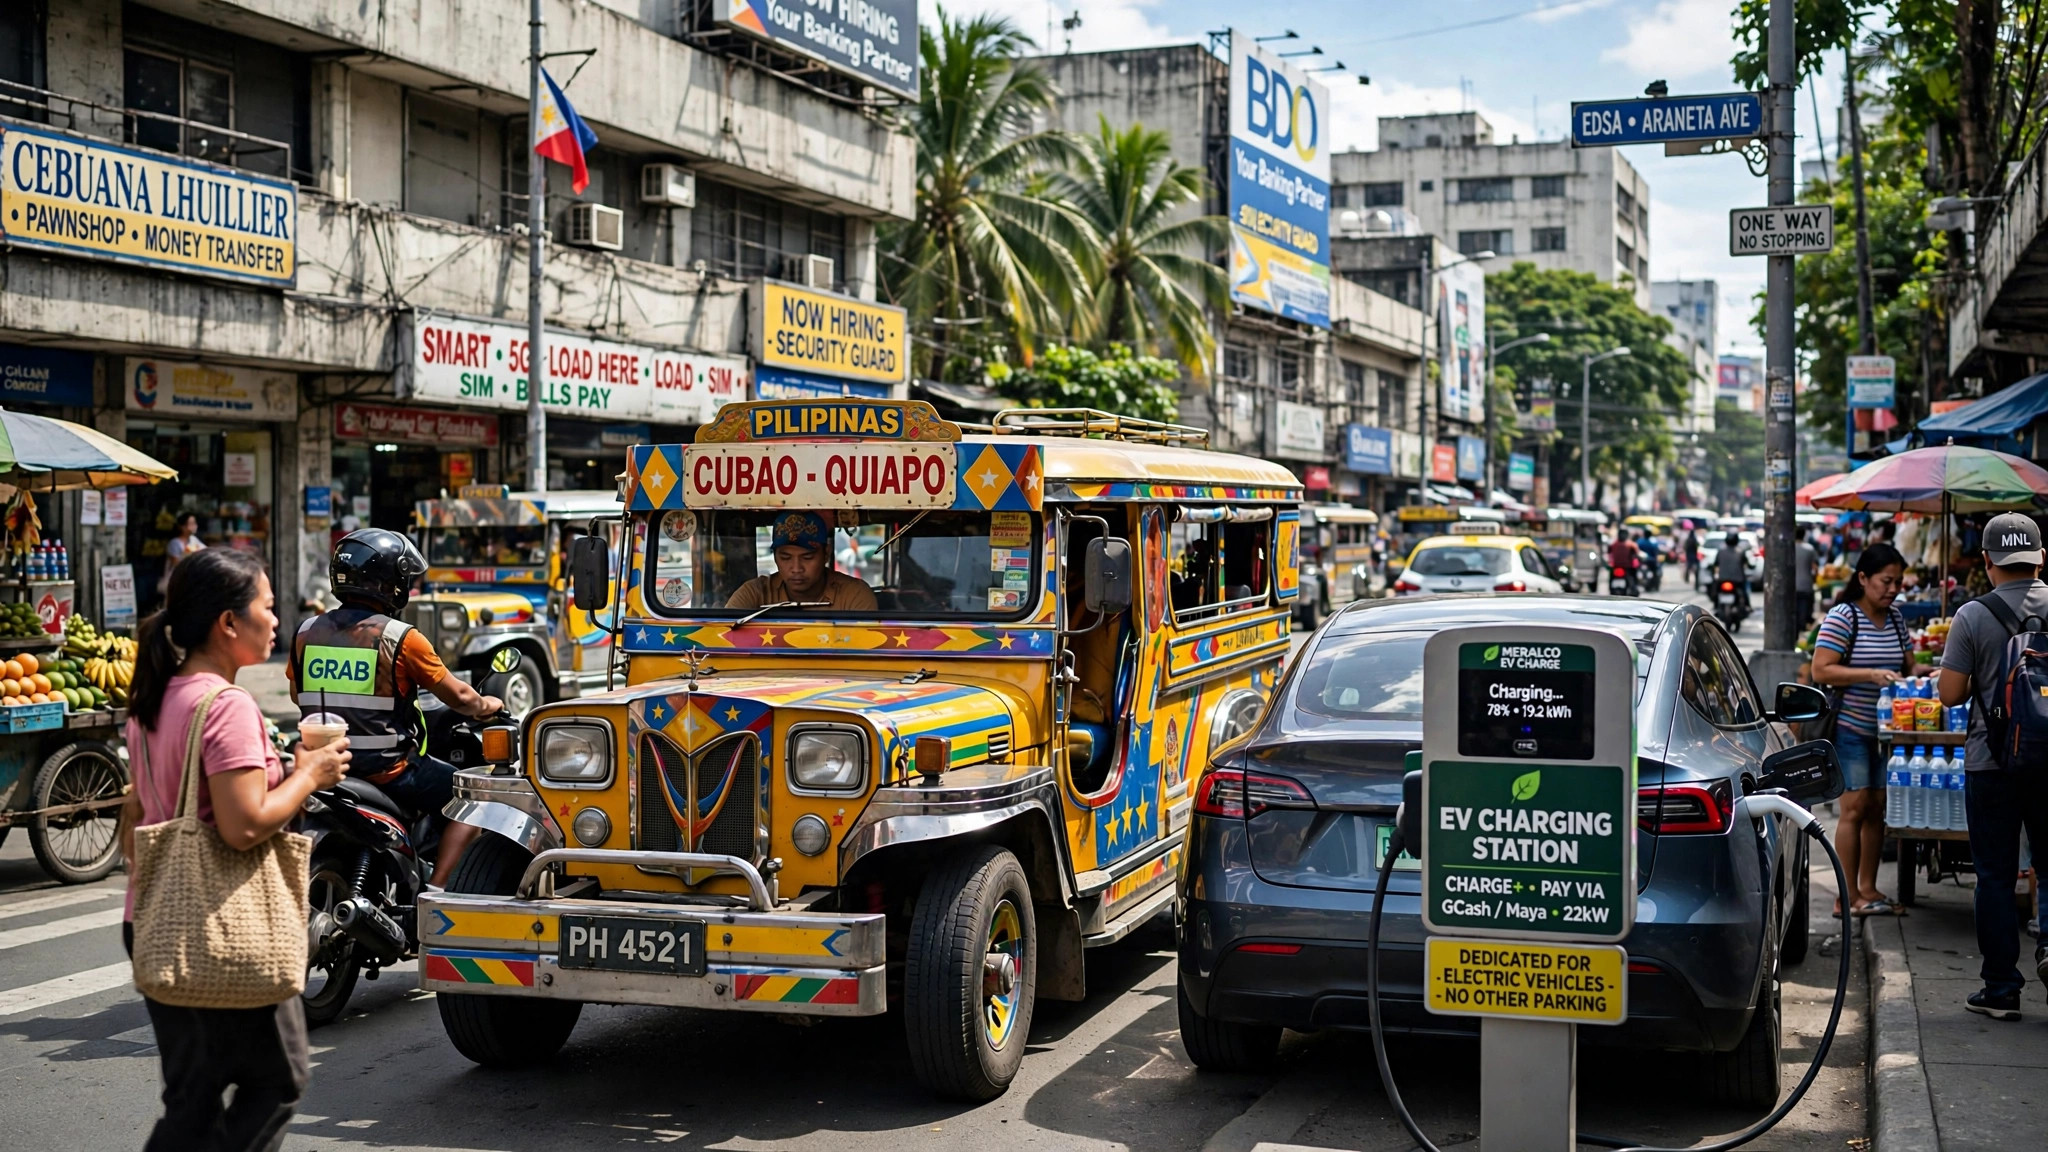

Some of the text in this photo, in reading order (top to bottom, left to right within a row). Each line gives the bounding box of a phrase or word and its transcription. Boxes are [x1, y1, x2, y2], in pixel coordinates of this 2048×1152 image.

[838, 0, 899, 45] HIRING
[767, 0, 913, 82] Your Banking Partner
[1248, 55, 1318, 162] BDO
[1582, 103, 1750, 136] EDSA ARANETA AVE
[12, 140, 289, 239] CEBUANA LHUILLIER
[1235, 147, 1258, 181] Your
[1258, 157, 1295, 206] Banking
[1739, 211, 1822, 232] ONE WAY
[26, 202, 284, 273] PAWNSHOP MONEY TRANSFER
[1740, 232, 1825, 248] NO STOPPING
[783, 295, 885, 342] NOW HIRING
[423, 326, 491, 369] SMART
[550, 345, 592, 380] LOAD
[598, 351, 639, 385] HERE
[655, 359, 694, 391] LOAD
[708, 366, 733, 395] SIM
[776, 329, 895, 372] SECURITY GUARD
[460, 372, 611, 409] SIM BLLS PAY
[755, 407, 899, 434] PILIPINAS
[693, 455, 798, 495] CUBAO
[825, 455, 945, 496] QUIAPO
[2001, 532, 2031, 547] MNL
[1500, 657, 1560, 670] EV CHARGE
[1501, 646, 1561, 659] MERALCO
[308, 657, 370, 682] GRAB
[1489, 683, 1564, 702] Charging...
[1487, 703, 1572, 719] 78% 19.2 kWh
[1440, 806, 1613, 836] EV CHARGING
[1472, 836, 1579, 864] STATION
[1541, 880, 1571, 897] PAY
[1576, 882, 1605, 899] VIA
[1441, 898, 1491, 917] GCash
[1506, 902, 1547, 922] Maya
[1563, 905, 1610, 923] 22kW
[569, 927, 692, 965] PH 4521
[1459, 949, 1591, 971] DEDICATED FOR
[1443, 968, 1604, 992] ELECTRIC VEHICLES
[1445, 988, 1607, 1013] NO OTHER PARKING
